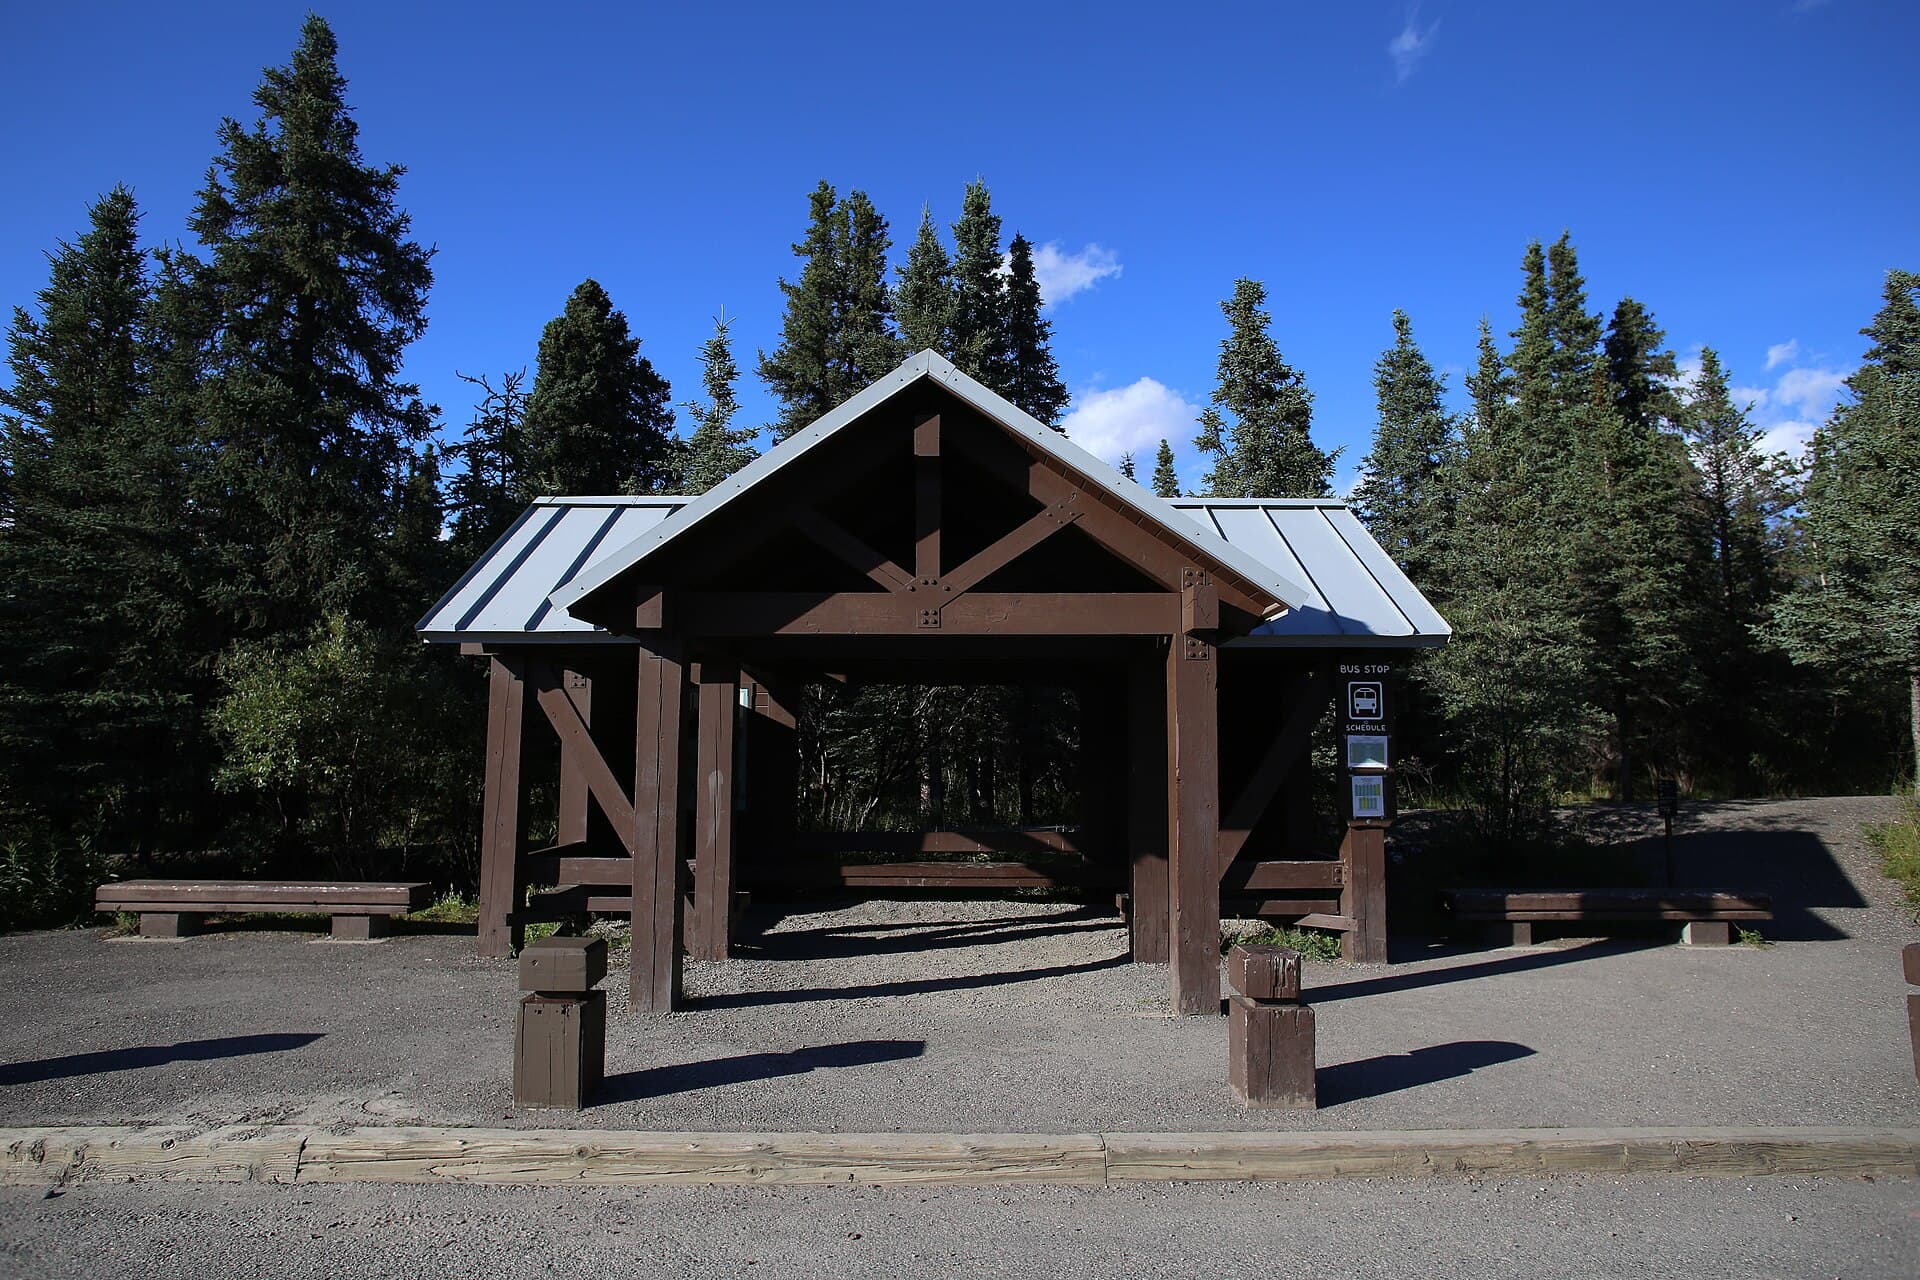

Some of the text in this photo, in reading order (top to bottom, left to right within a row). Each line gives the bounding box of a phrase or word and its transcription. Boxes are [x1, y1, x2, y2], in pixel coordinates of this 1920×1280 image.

[1340, 664, 1390, 674] BUS STOP
[1345, 724, 1386, 732] SCHEDULE
